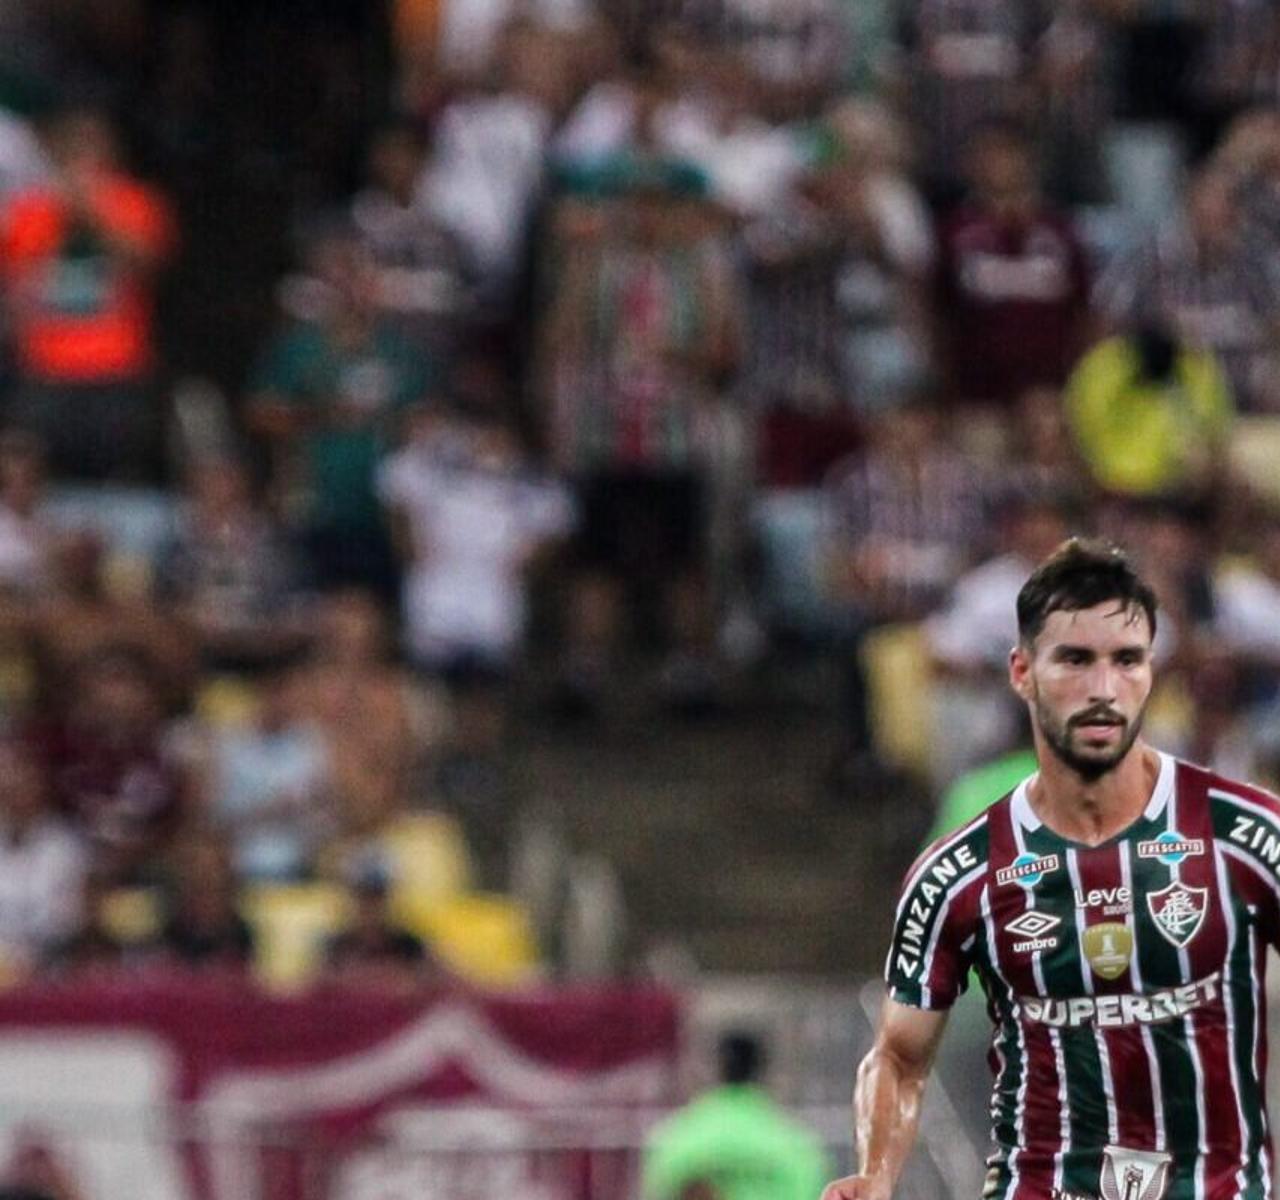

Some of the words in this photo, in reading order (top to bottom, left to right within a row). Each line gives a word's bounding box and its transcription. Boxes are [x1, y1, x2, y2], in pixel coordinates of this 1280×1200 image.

[896, 844, 978, 979] ZINZANE
[1073, 887, 1131, 908] Leve
[1012, 937, 1057, 953] umbro
[1022, 971, 1220, 1027] SUPERBET
